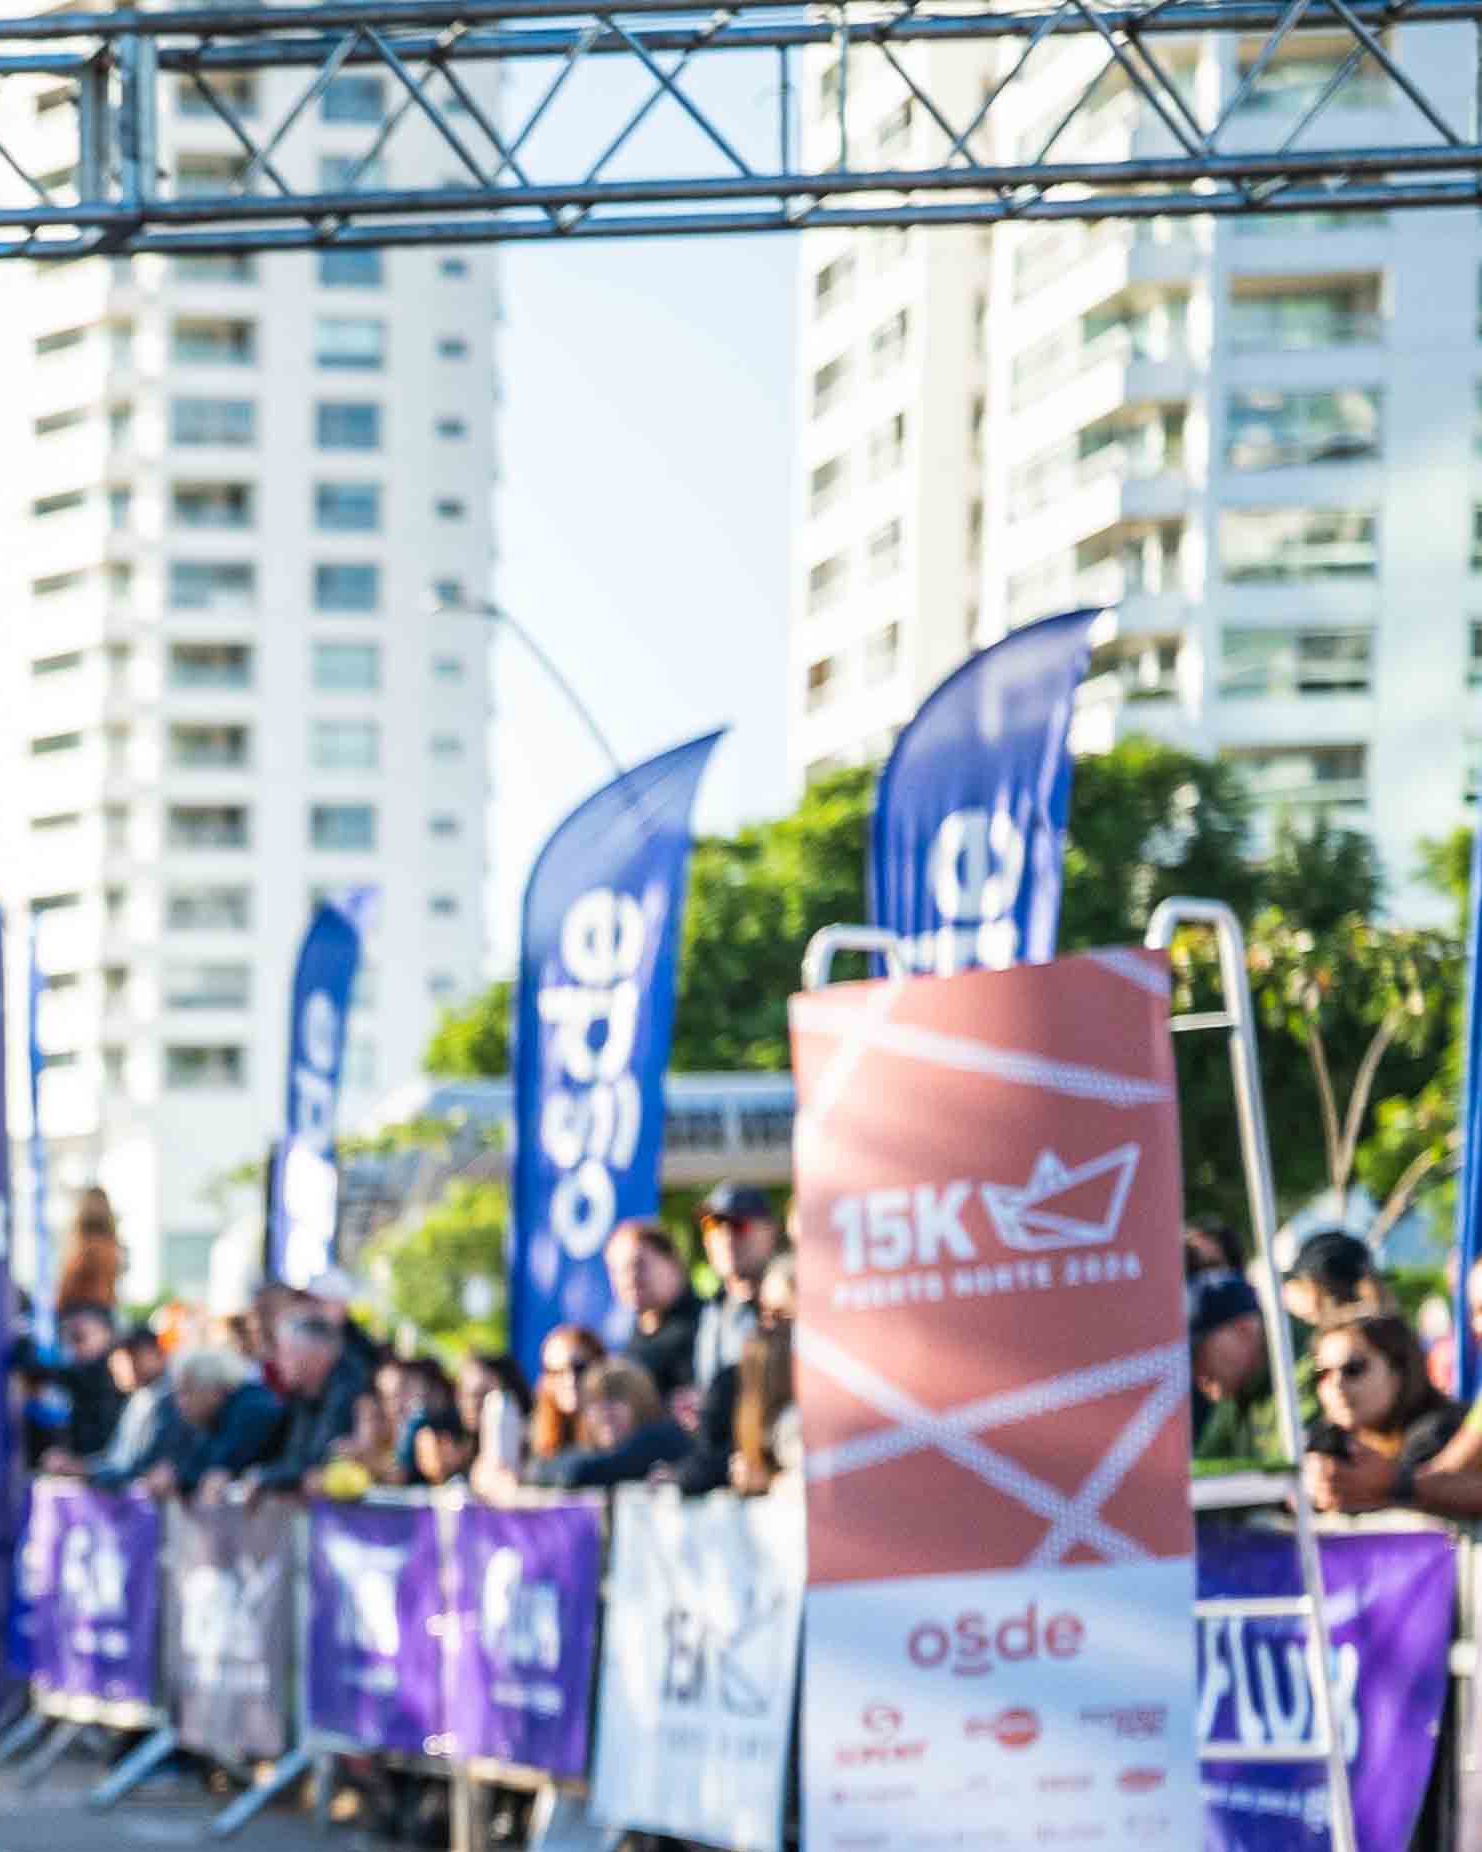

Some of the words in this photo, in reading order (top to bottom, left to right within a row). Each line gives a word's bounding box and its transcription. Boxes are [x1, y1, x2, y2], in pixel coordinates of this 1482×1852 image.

[538, 887, 645, 1262] osde
[830, 1181, 979, 1275] 15K
[907, 1598, 1086, 1677] osde
